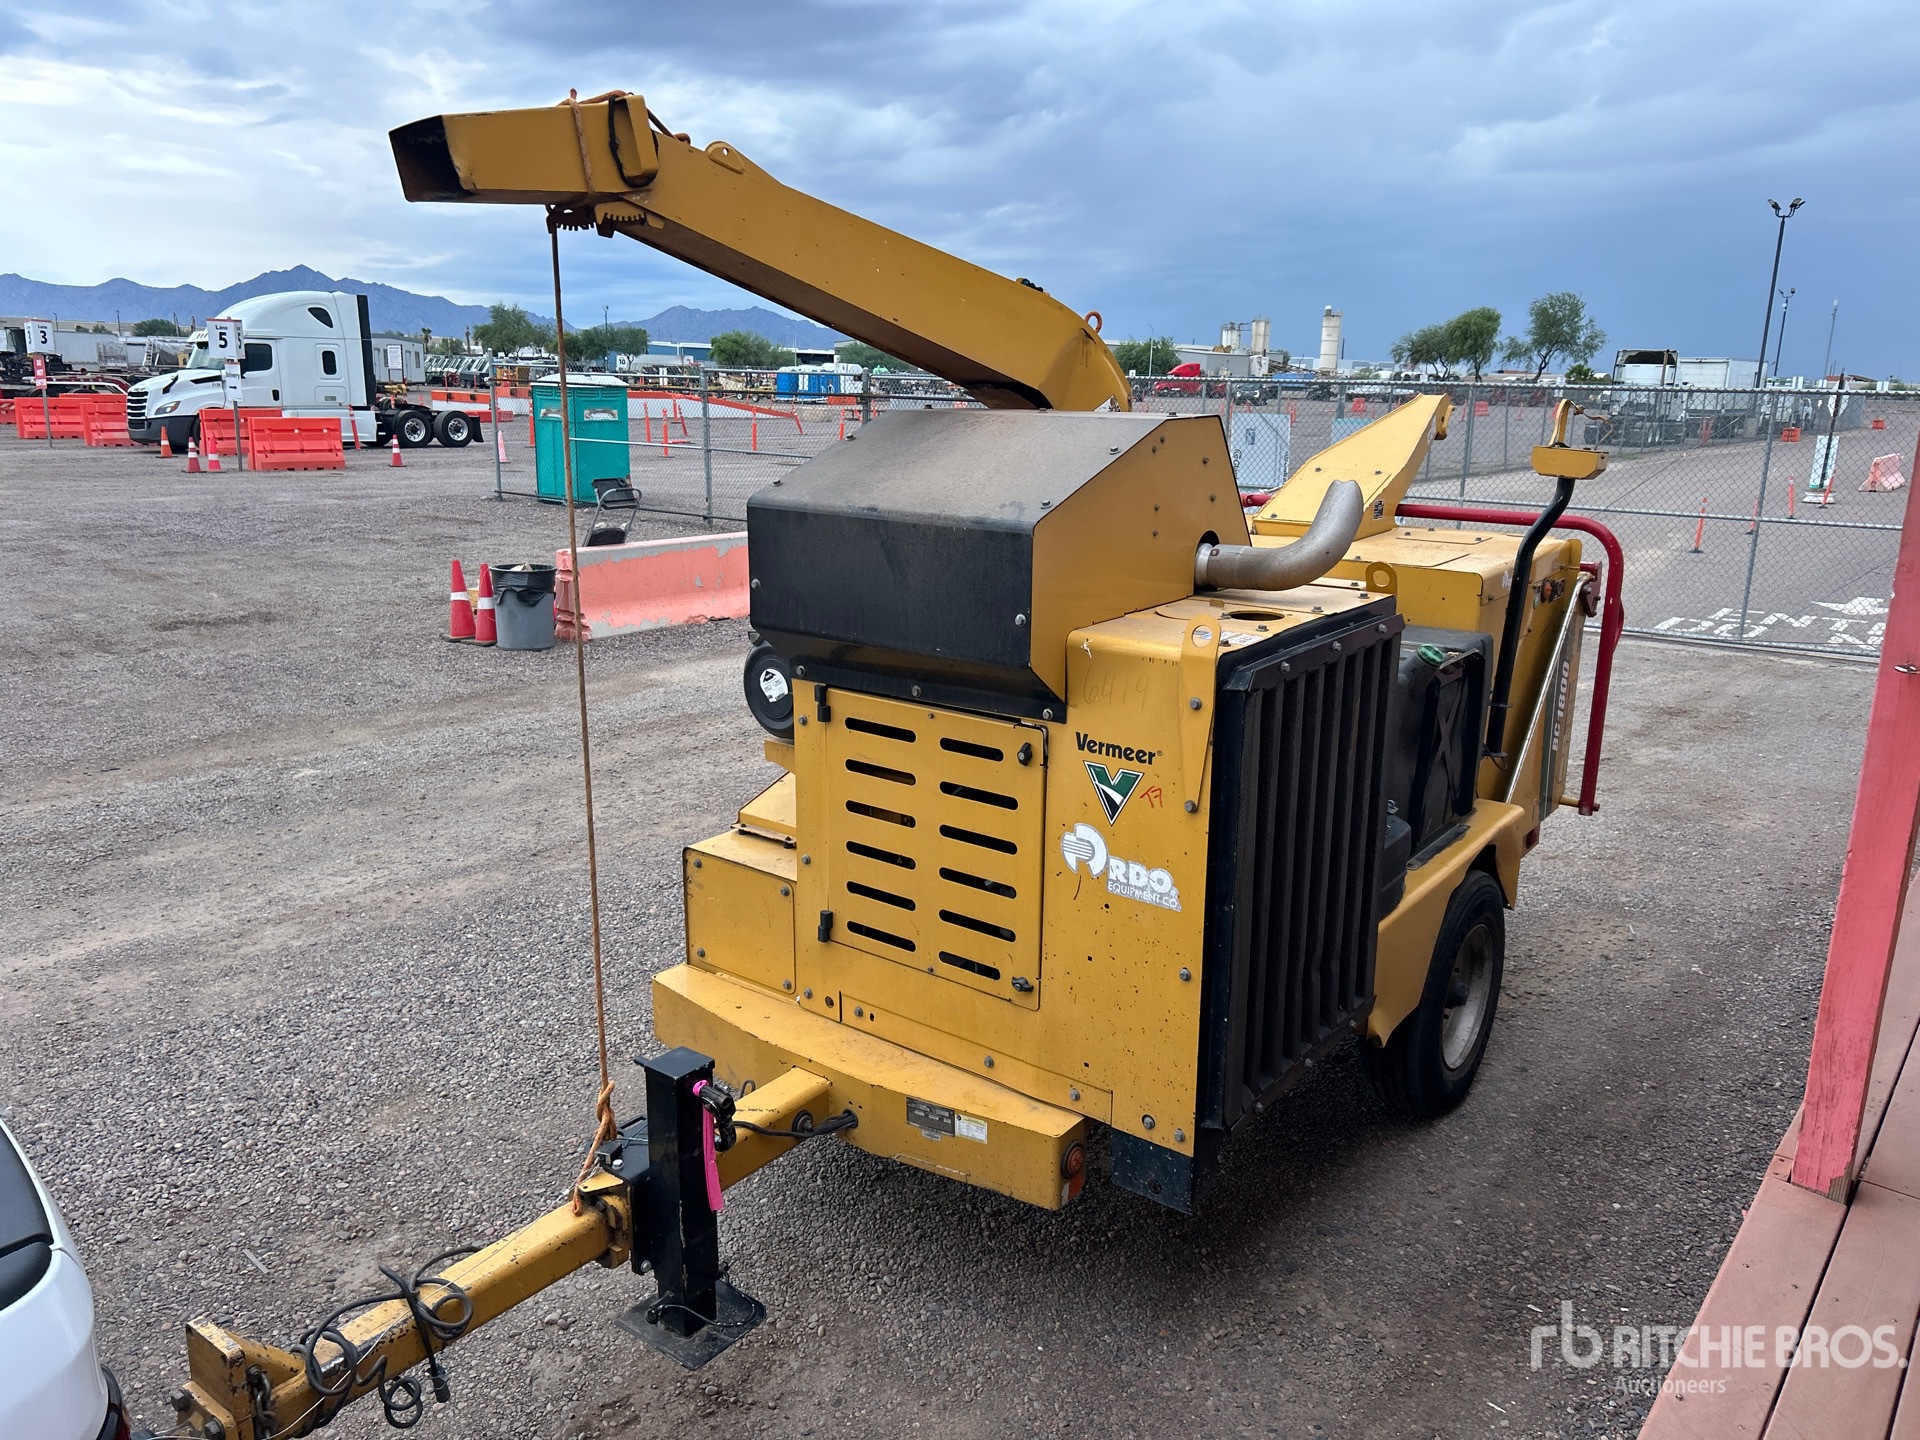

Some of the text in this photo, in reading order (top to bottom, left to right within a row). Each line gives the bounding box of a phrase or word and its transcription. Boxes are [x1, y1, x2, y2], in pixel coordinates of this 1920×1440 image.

[40, 330, 47, 344] 3
[219, 332, 228, 348] 5
[1552, 661, 1570, 751] BC1800
[1075, 731, 1157, 766] Vermeer
[1107, 856, 1174, 894] RDO
[1107, 881, 1160, 905] EQUIPMENT
